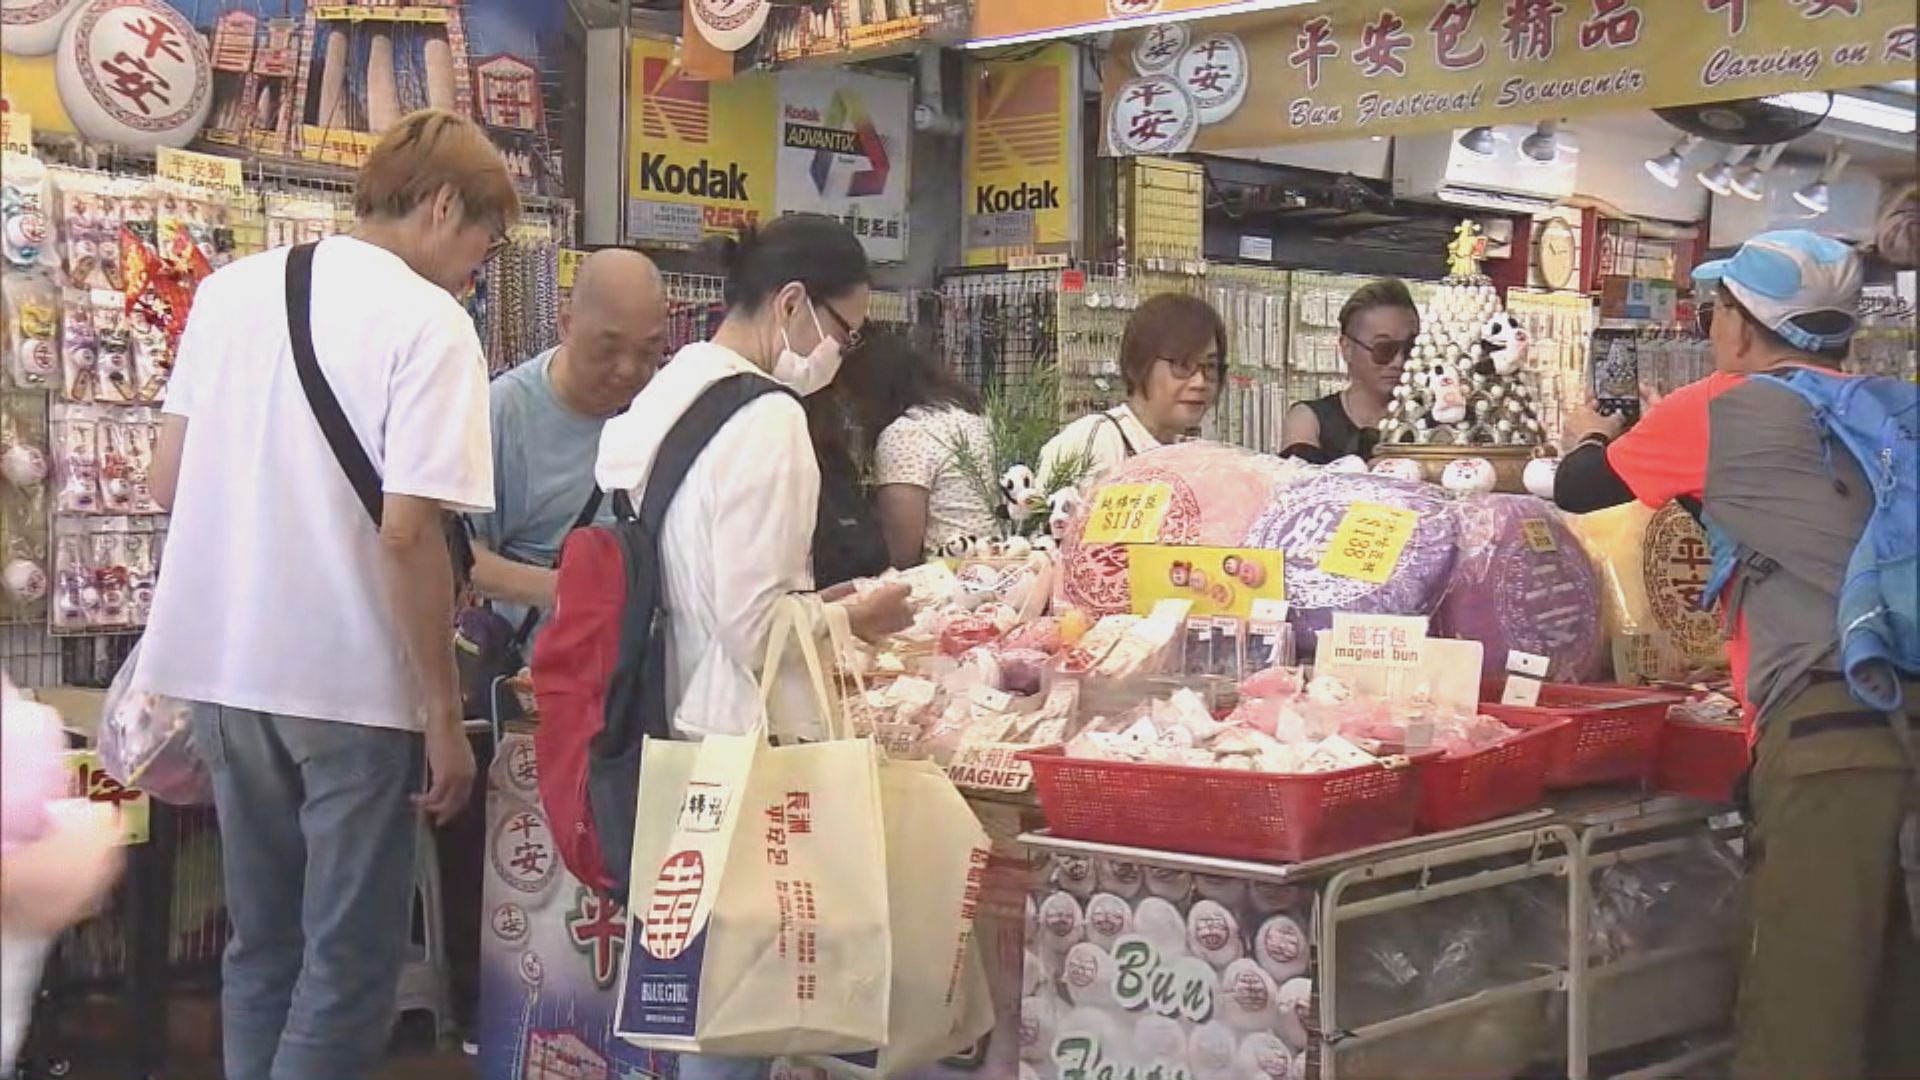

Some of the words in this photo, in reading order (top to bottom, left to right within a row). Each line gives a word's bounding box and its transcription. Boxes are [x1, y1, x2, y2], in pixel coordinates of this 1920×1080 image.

[1188, 39, 1232, 93] 平安
[1289, 0, 1643, 87] 平安包精品
[1703, 49, 1820, 85] Carving
[1834, 44, 1867, 64] on
[784, 104, 820, 121] Kodak
[1126, 84, 1178, 145] 平安
[1289, 100, 1341, 127] Bun
[1357, 84, 1483, 124] Festival
[1499, 69, 1643, 107] Souvenir
[641, 152, 749, 201] Kodak
[977, 180, 1059, 214] Kodak
[1334, 647, 1385, 661] magnet
[1392, 649, 1419, 662] bun
[950, 765, 1030, 788] MAGNET
[510, 813, 548, 875] 平安
[1114, 940, 1206, 1013] Bun
